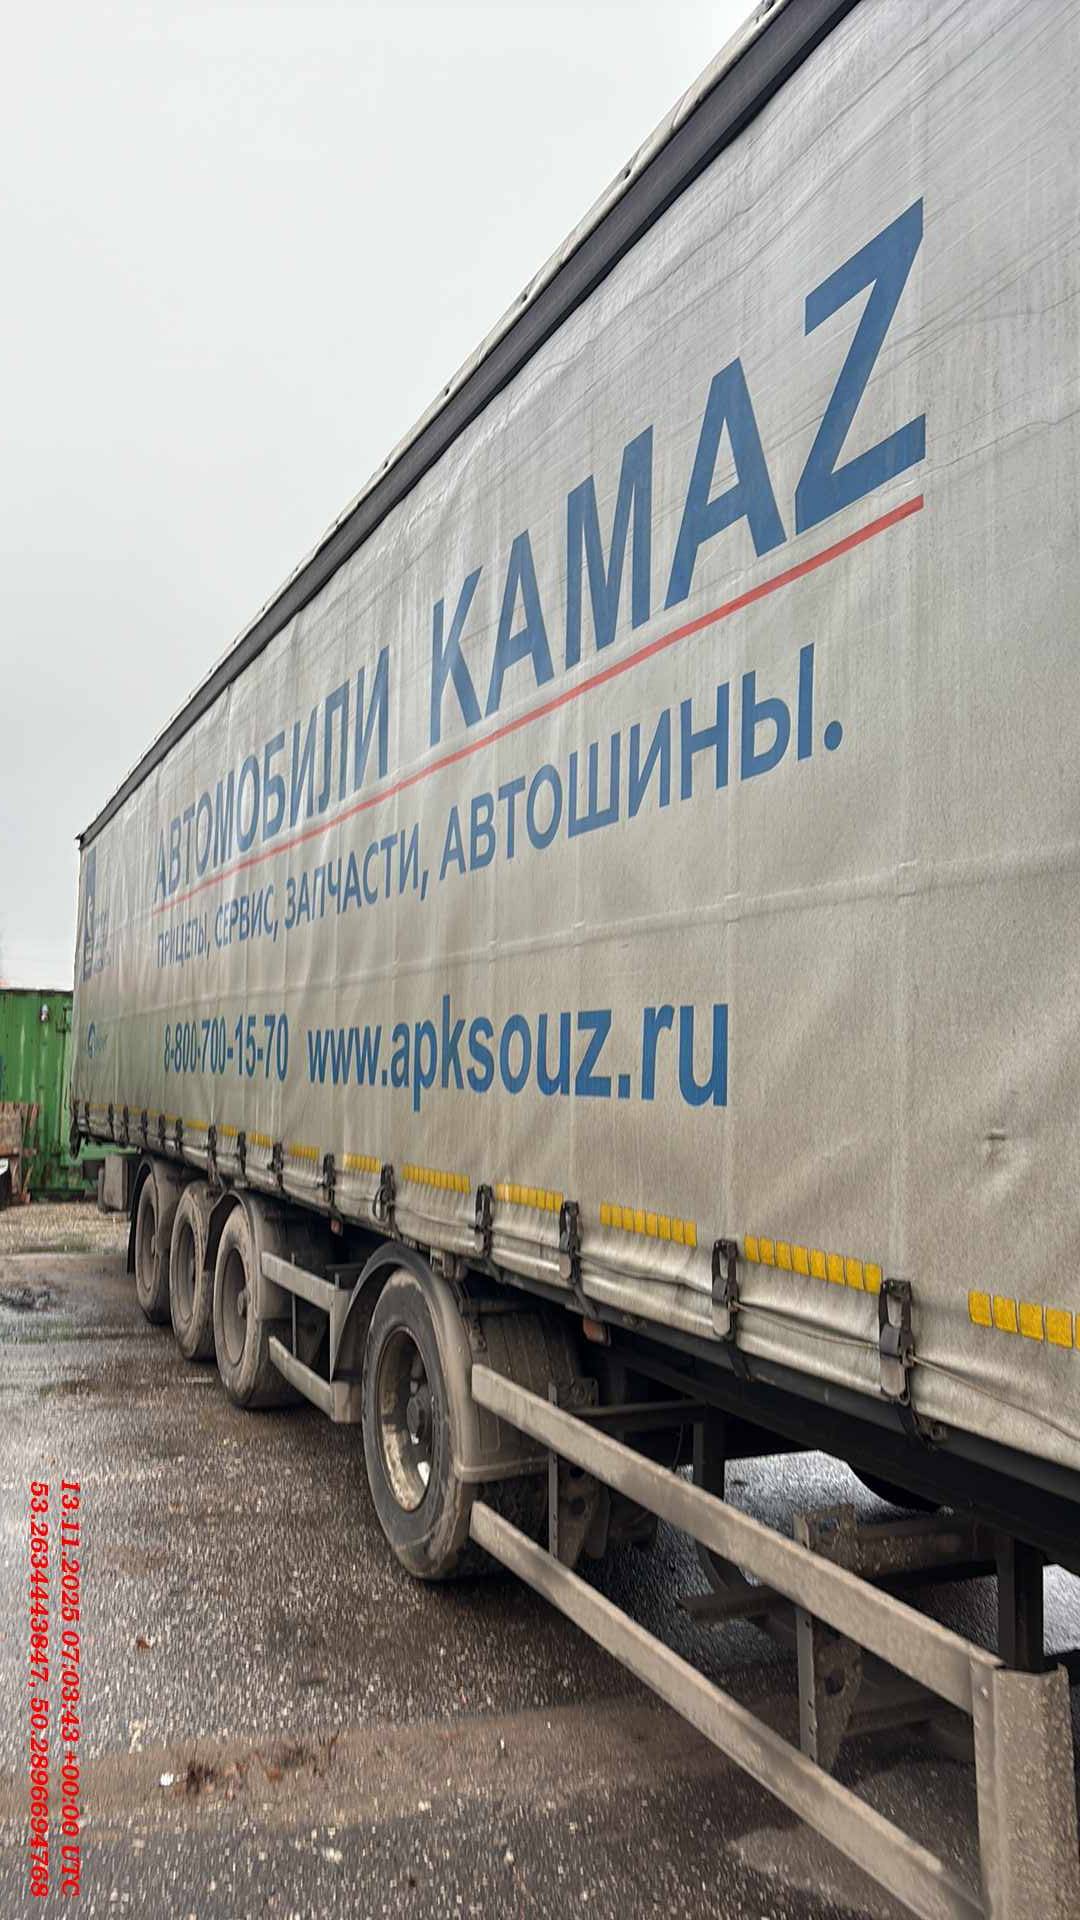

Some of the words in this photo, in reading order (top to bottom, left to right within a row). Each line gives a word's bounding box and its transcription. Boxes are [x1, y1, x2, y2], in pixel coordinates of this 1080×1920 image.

[155, 645, 389, 902] АВТОМОБИЛИ
[430, 197, 926, 744] KAMAZ
[157, 913, 210, 968] ПРИЦЕПЫ,
[215, 884, 278, 948] СЕРВИС,
[284, 822, 428, 929] ЗАПЧАСТИ,
[439, 642, 843, 880] АВТОШИНЫ.
[163, 1013, 289, 1081] 8-800-700-15-70
[307, 994, 729, 1112] www.apksouz.ru
